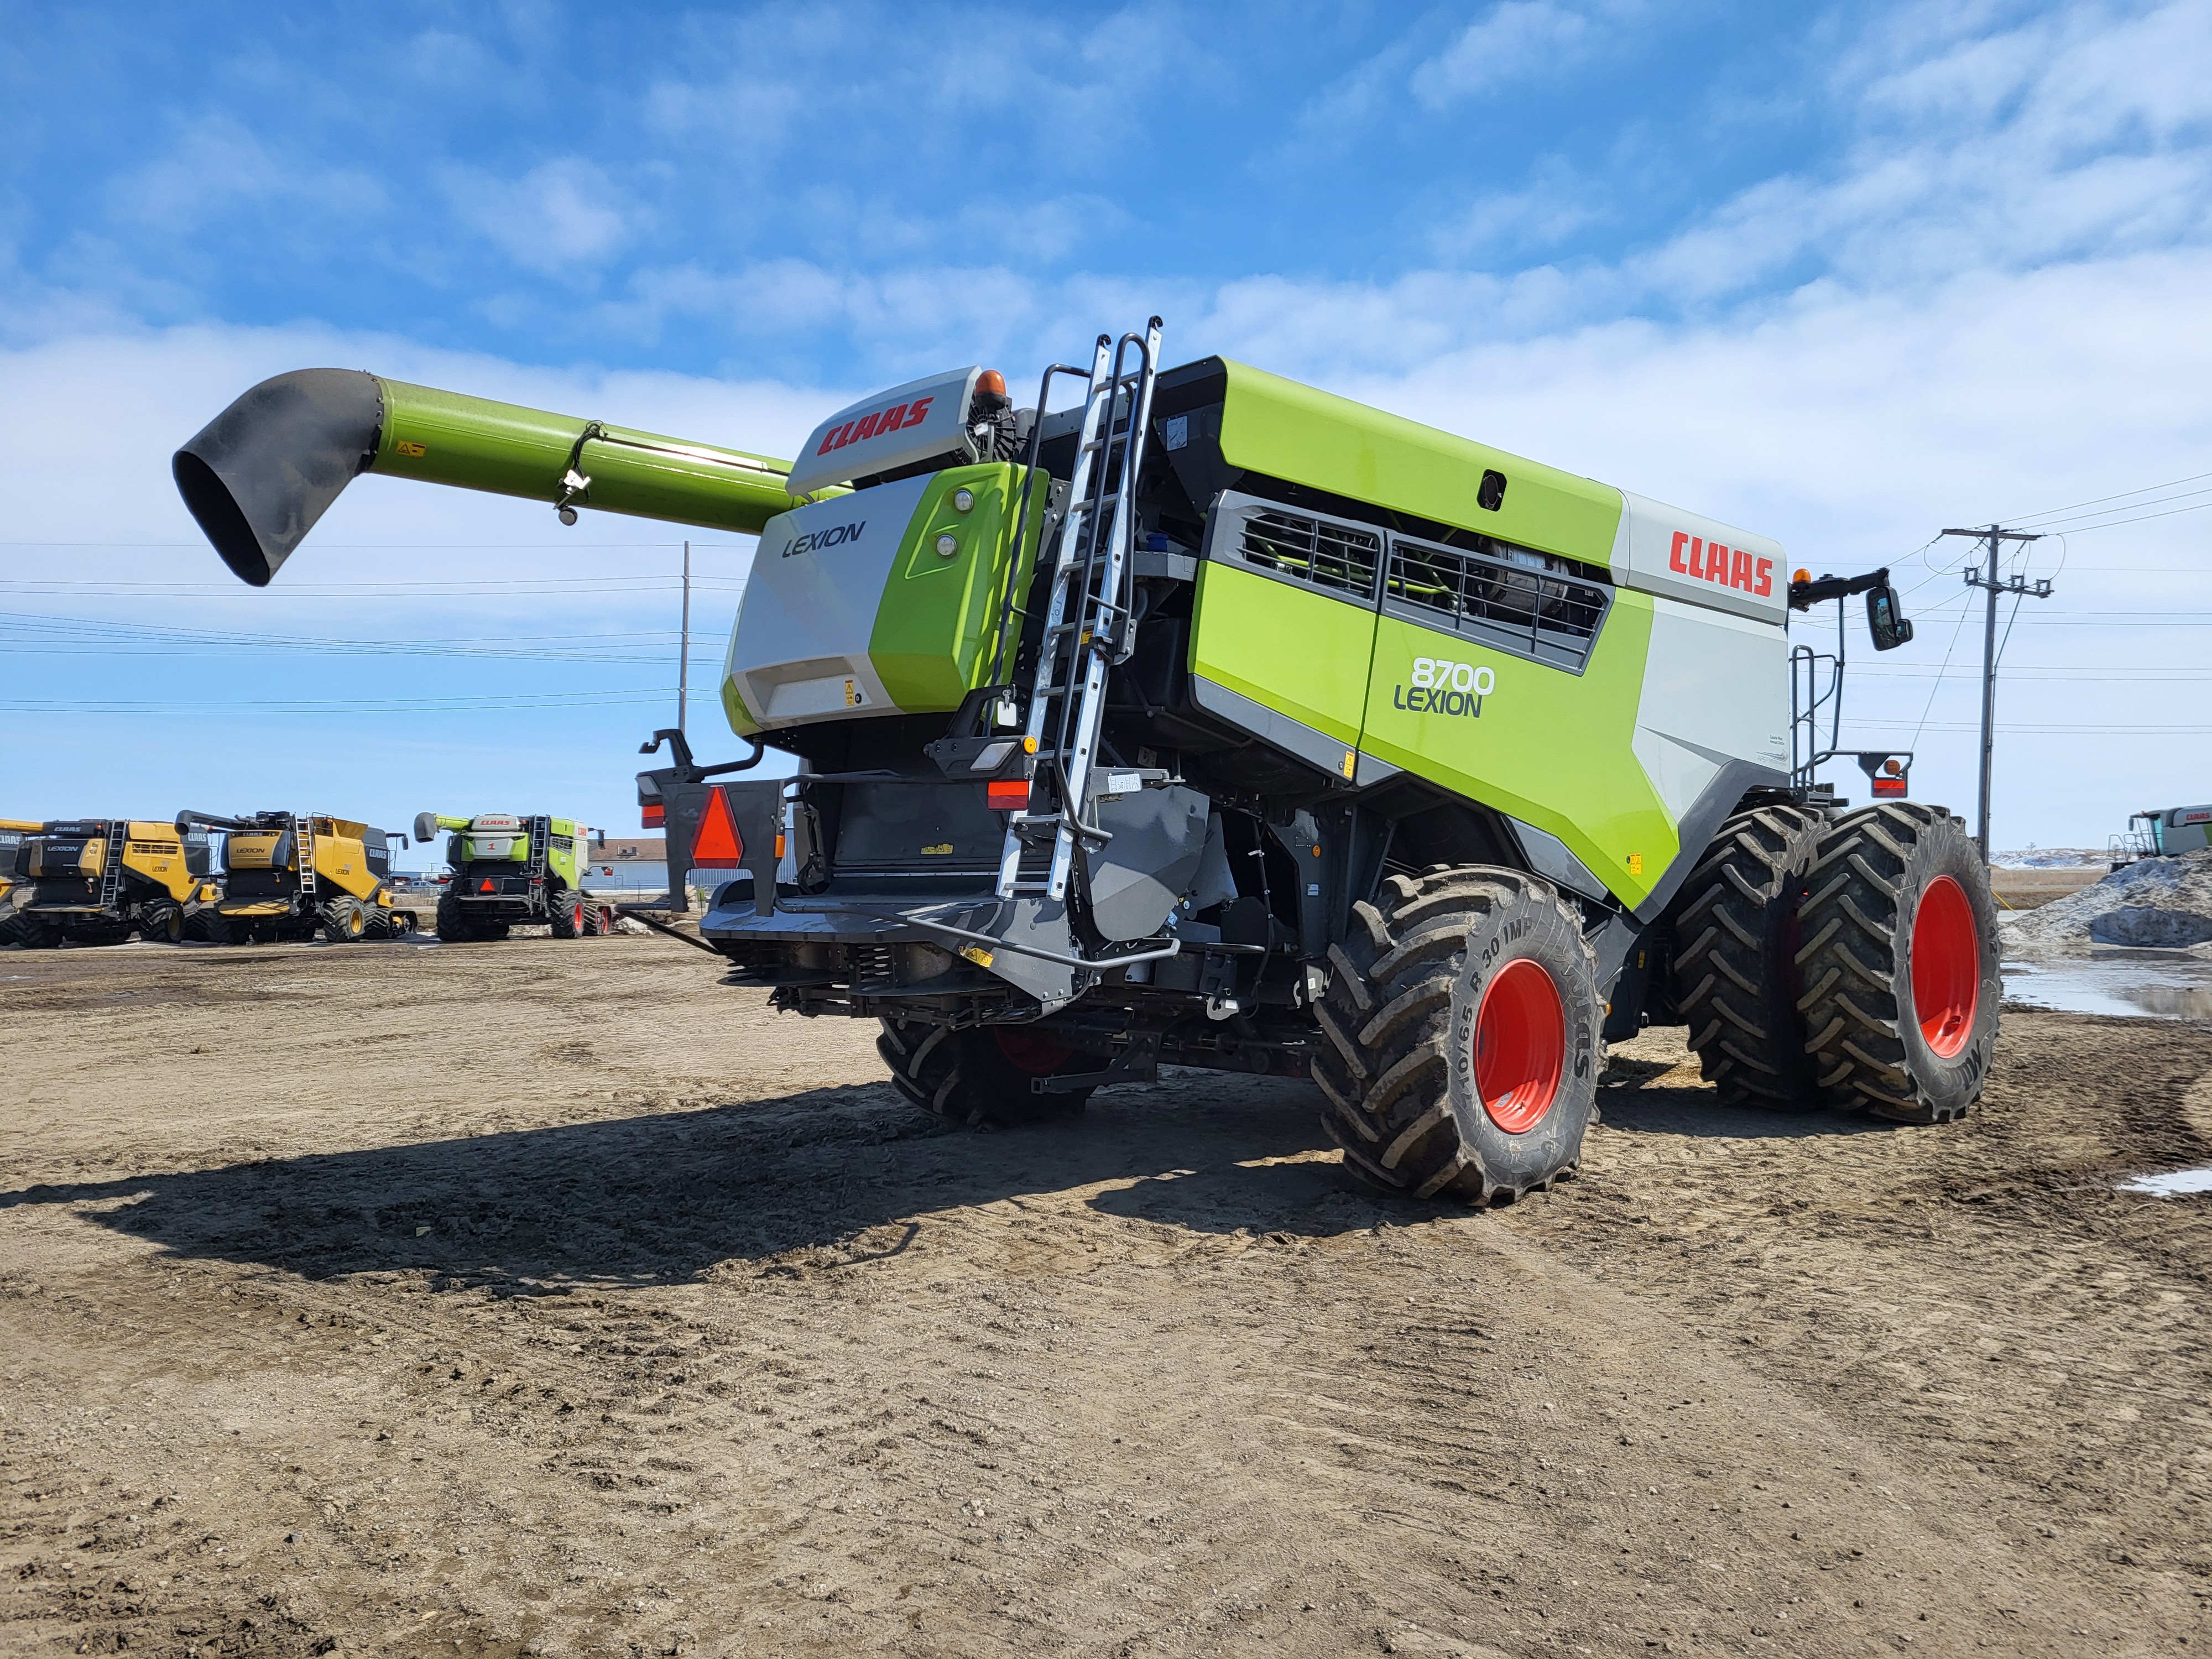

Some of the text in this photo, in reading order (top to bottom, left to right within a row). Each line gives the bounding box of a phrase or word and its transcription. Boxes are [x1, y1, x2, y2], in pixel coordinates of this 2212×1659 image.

[817, 397, 935, 456] CLAAS
[782, 520, 867, 559] LEXION
[1669, 530, 1773, 598] CLAAS
[1411, 657, 1495, 695] 8700
[1394, 684, 1483, 718] LEXION
[187, 832, 206, 842] CLAAS
[369, 848, 387, 860] CLAAS
[1457, 916, 1532, 1109] 710/65 R 30 IMP
